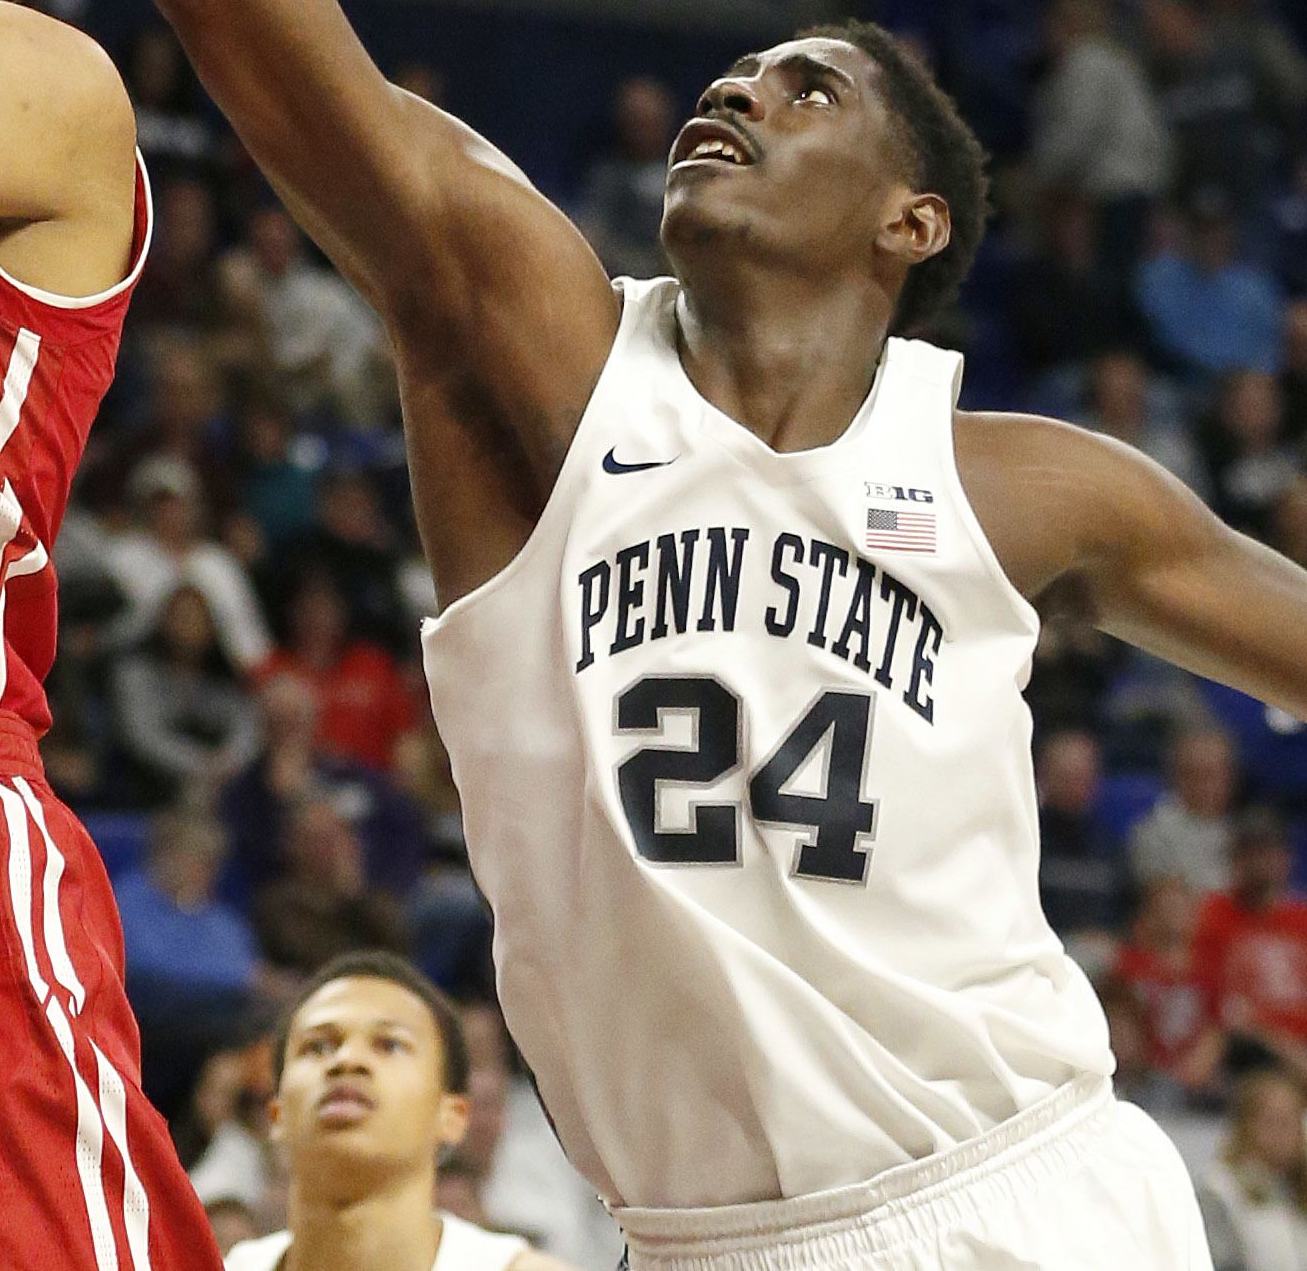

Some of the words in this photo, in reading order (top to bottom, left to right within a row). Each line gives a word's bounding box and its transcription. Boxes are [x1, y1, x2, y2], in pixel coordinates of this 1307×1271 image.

[576, 526, 750, 674] PENN
[764, 531, 944, 726] STATE
[612, 672, 881, 888] 24
